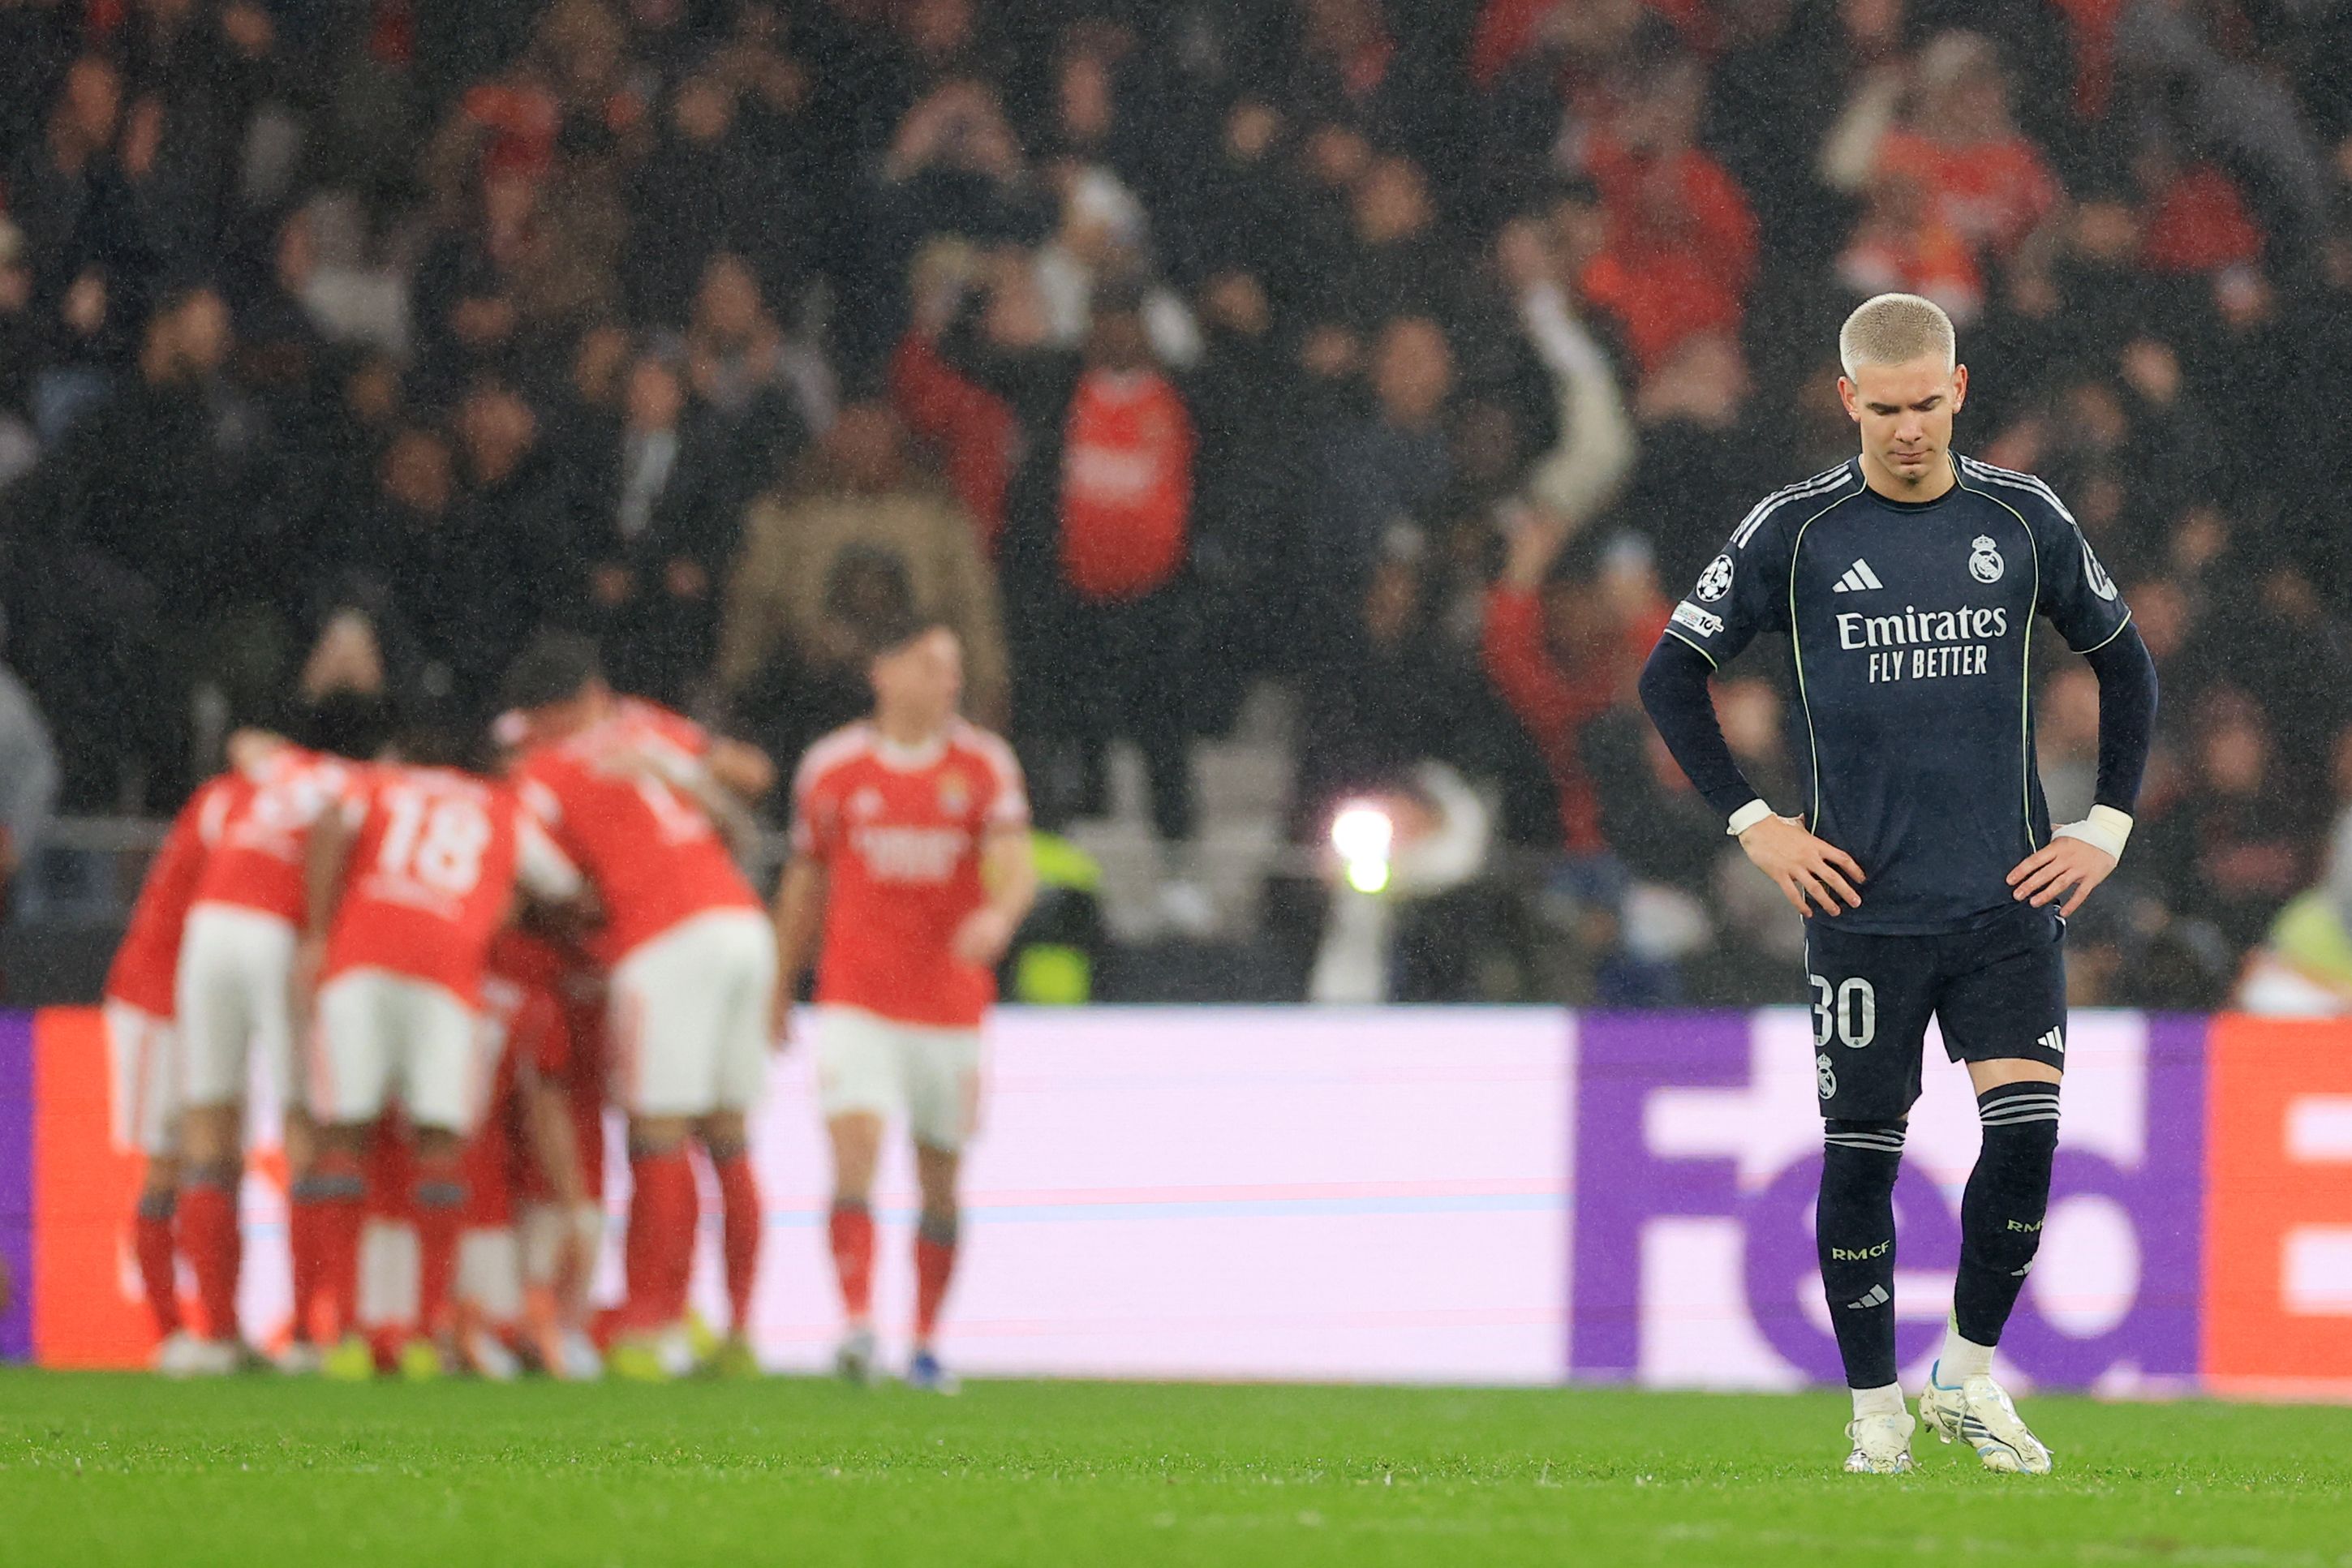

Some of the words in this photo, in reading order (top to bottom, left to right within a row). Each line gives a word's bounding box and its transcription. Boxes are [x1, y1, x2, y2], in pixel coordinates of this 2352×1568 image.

[1835, 604, 2007, 650] Emirates
[1868, 650, 1905, 683] FLY
[1912, 645, 1988, 678] BETTER
[376, 782, 492, 897] 18
[1810, 973, 1876, 1049] 30
[1572, 1012, 2352, 1397] FedE
[2006, 1218, 2045, 1233] RM
[1832, 1239, 1890, 1261] RMCF
